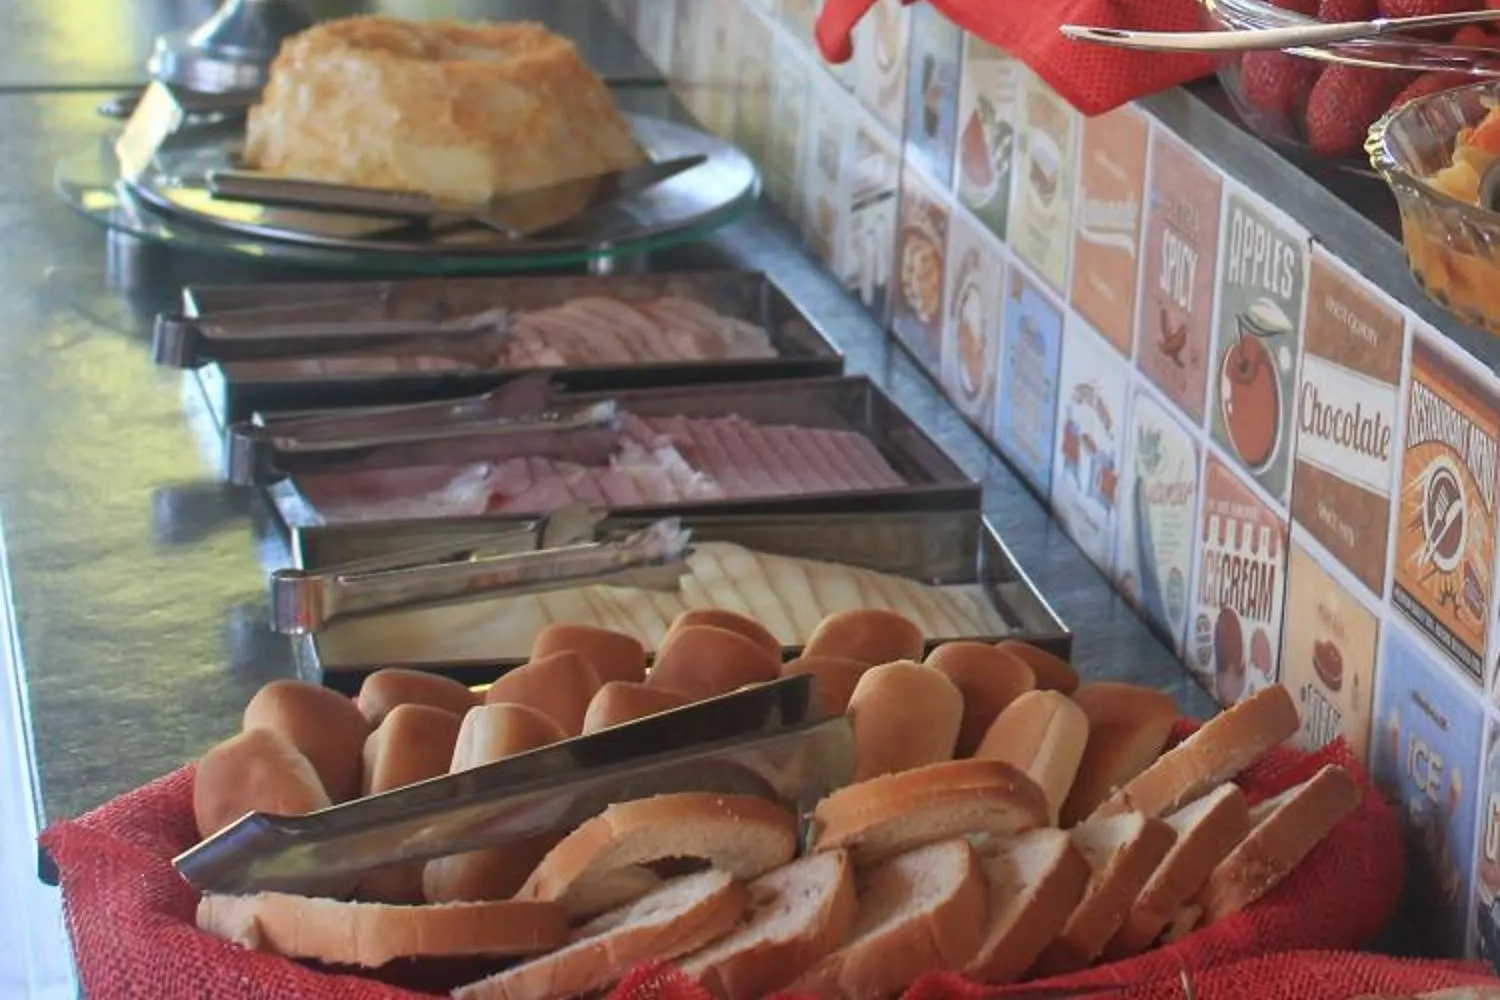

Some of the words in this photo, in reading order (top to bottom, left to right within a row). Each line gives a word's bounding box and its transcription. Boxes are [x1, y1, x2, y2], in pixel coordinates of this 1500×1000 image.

[1159, 228, 1198, 313] SPICY
[1228, 208, 1295, 299] APPLES
[1300, 381, 1391, 461] Chocolate
